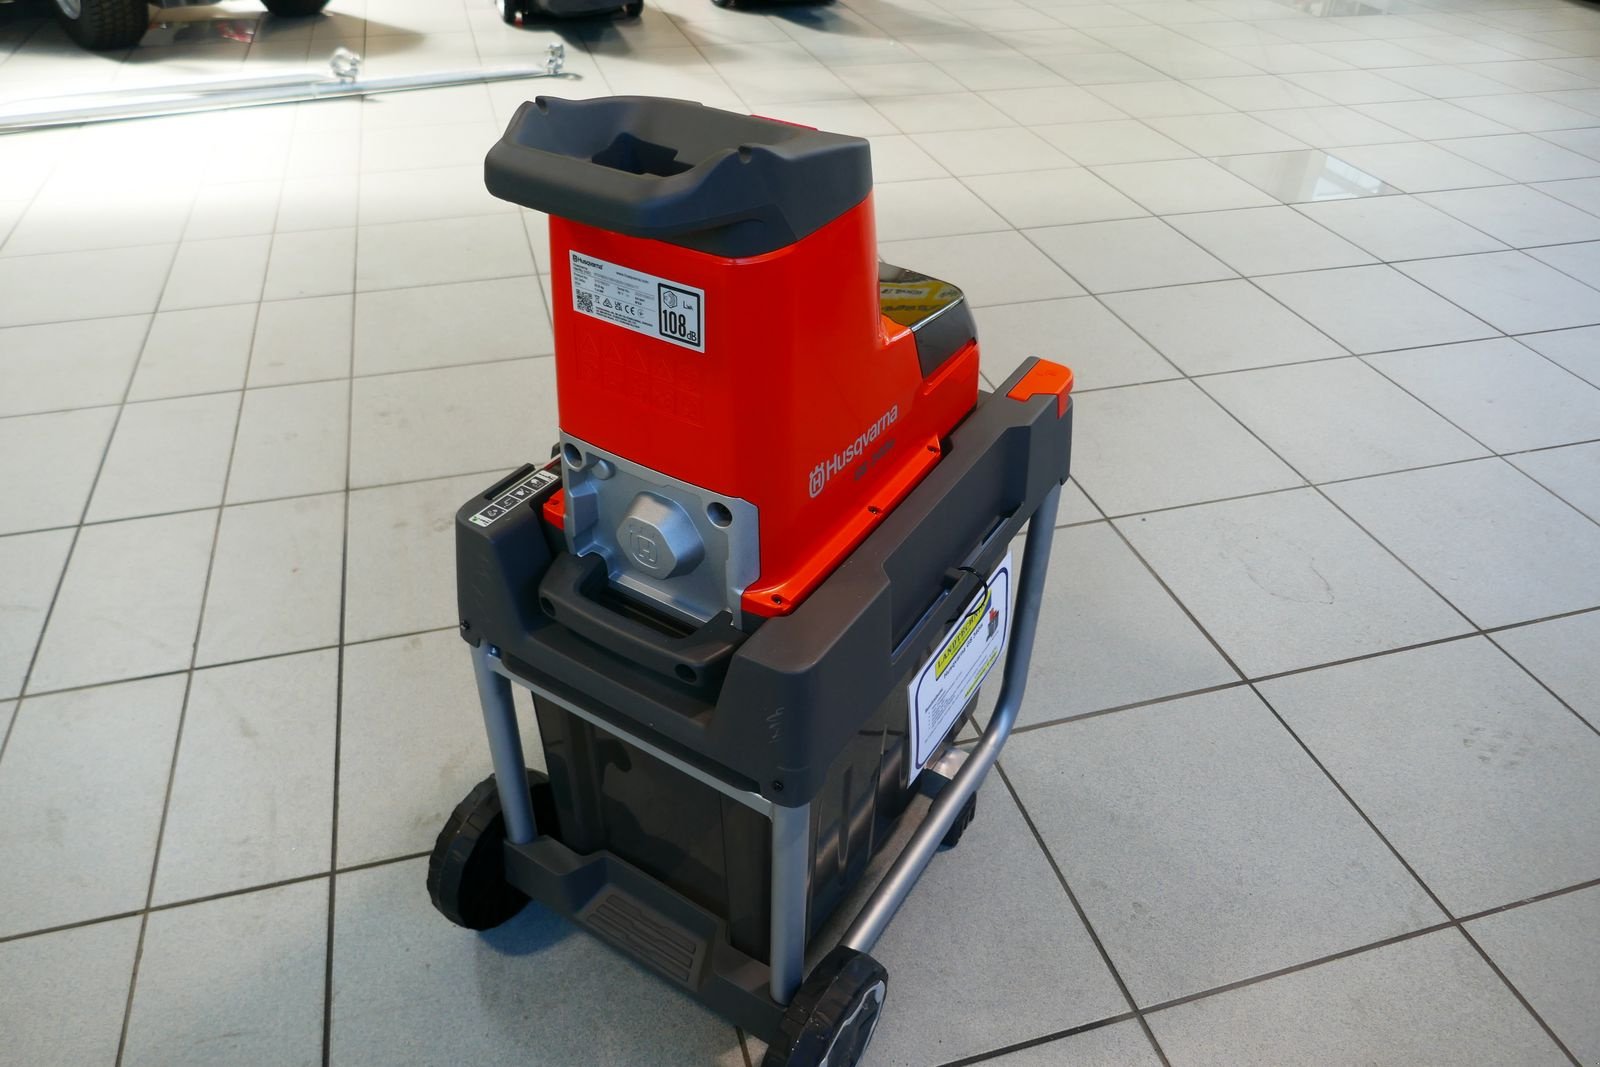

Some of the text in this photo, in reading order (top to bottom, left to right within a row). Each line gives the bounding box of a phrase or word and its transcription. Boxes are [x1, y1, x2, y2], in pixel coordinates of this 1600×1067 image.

[577, 256, 603, 270] Husqvarna
[662, 309, 686, 338] 108
[686, 330, 697, 341] dB
[826, 403, 898, 481] Husqvarna
